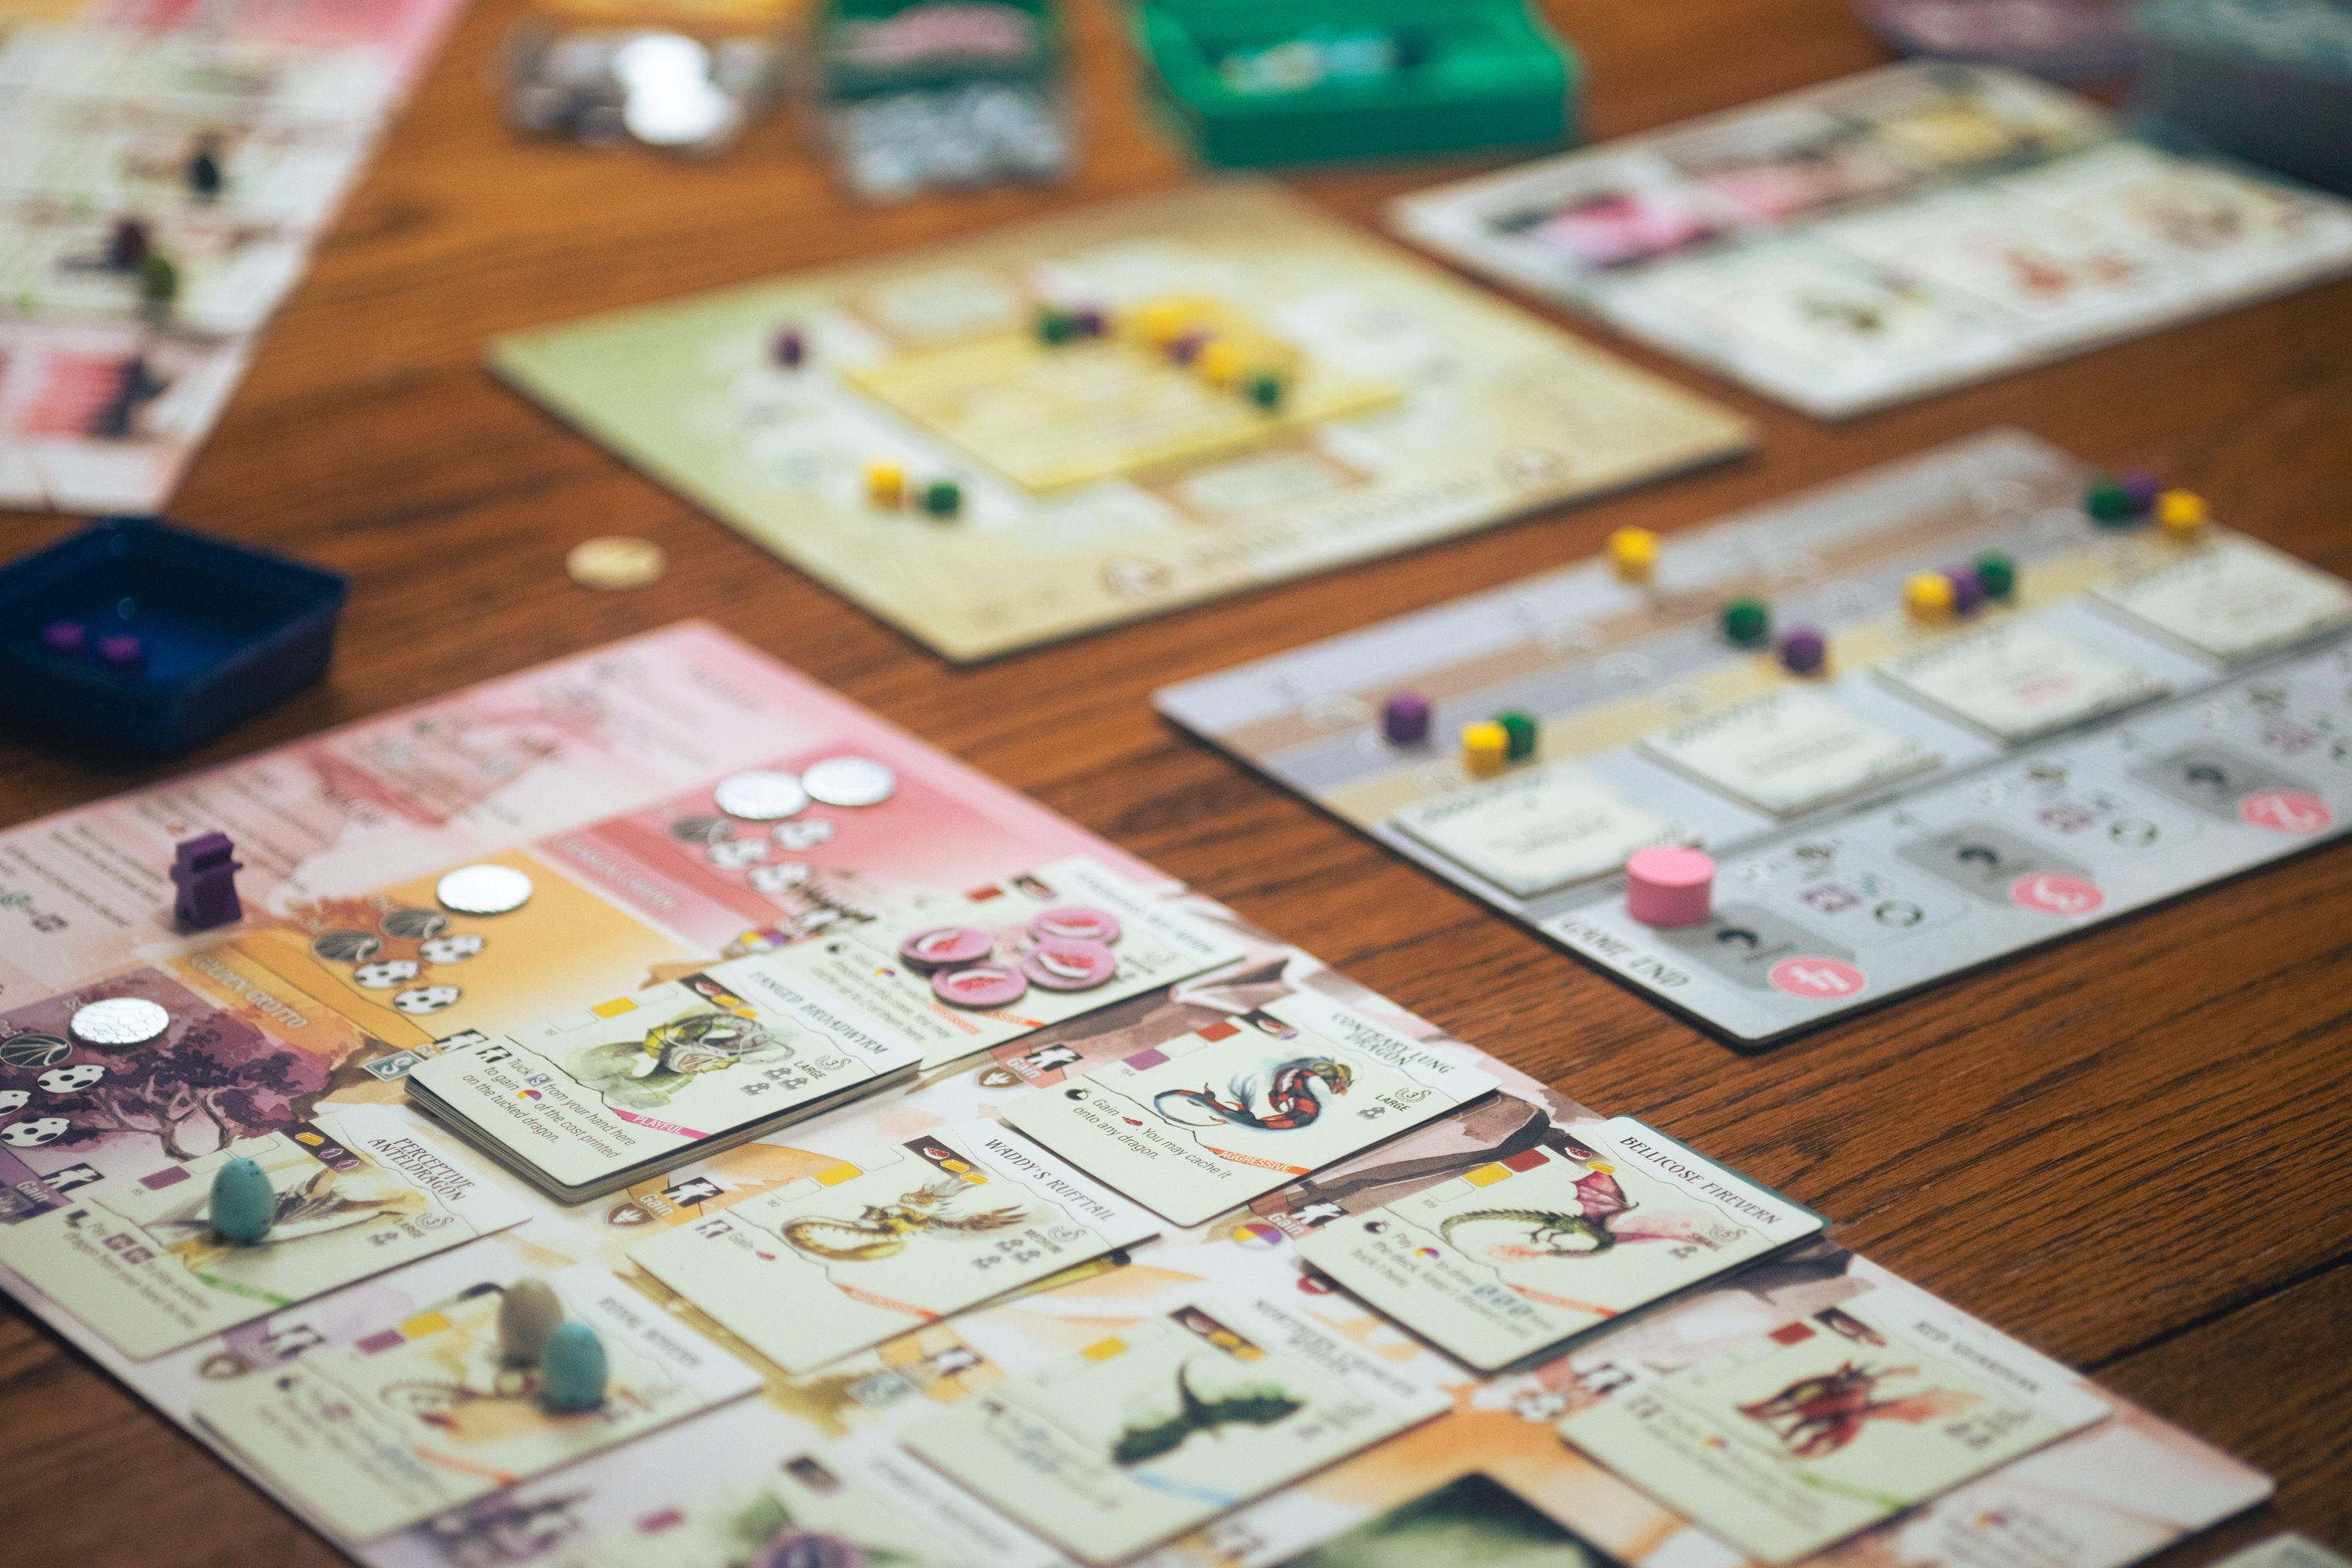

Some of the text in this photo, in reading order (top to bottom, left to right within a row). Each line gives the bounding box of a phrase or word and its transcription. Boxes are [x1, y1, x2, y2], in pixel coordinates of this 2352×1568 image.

[1629, 955, 1690, 987] END
[245, 989, 308, 1029] GROTTO
[800, 1003, 889, 1054] BROADWYRM
[1331, 1013, 1454, 1074] CONTRARY LUNG
[1344, 1033, 1411, 1066] DRAGON
[793, 1060, 827, 1080] LARGE
[1006, 1057, 1041, 1080] Gain
[463, 1074, 561, 1143] on the tucked dragon.
[484, 1065, 622, 1159] to gain of the cost printed
[507, 1058, 636, 1146] Tuck from your hand here
[633, 1115, 684, 1134] PLAYFUL
[1374, 1094, 1411, 1112] LARGE
[1073, 1106, 1158, 1160] onto any dragon.
[1092, 1098, 1233, 1180] Gain You may cache it
[367, 1138, 467, 1202] ANTELDRAGON
[392, 1137, 476, 1190] PERCEPTIVE
[985, 1138, 1116, 1222] WADDY'S RUFFTAIL
[1219, 1150, 1293, 1173] AGGRESSIVE
[1619, 1136, 1782, 1225] BELLICOSE FIREVERN
[16, 1181, 49, 1203] Gain
[639, 1192, 674, 1216] Gain
[1268, 1212, 1305, 1236] Gain
